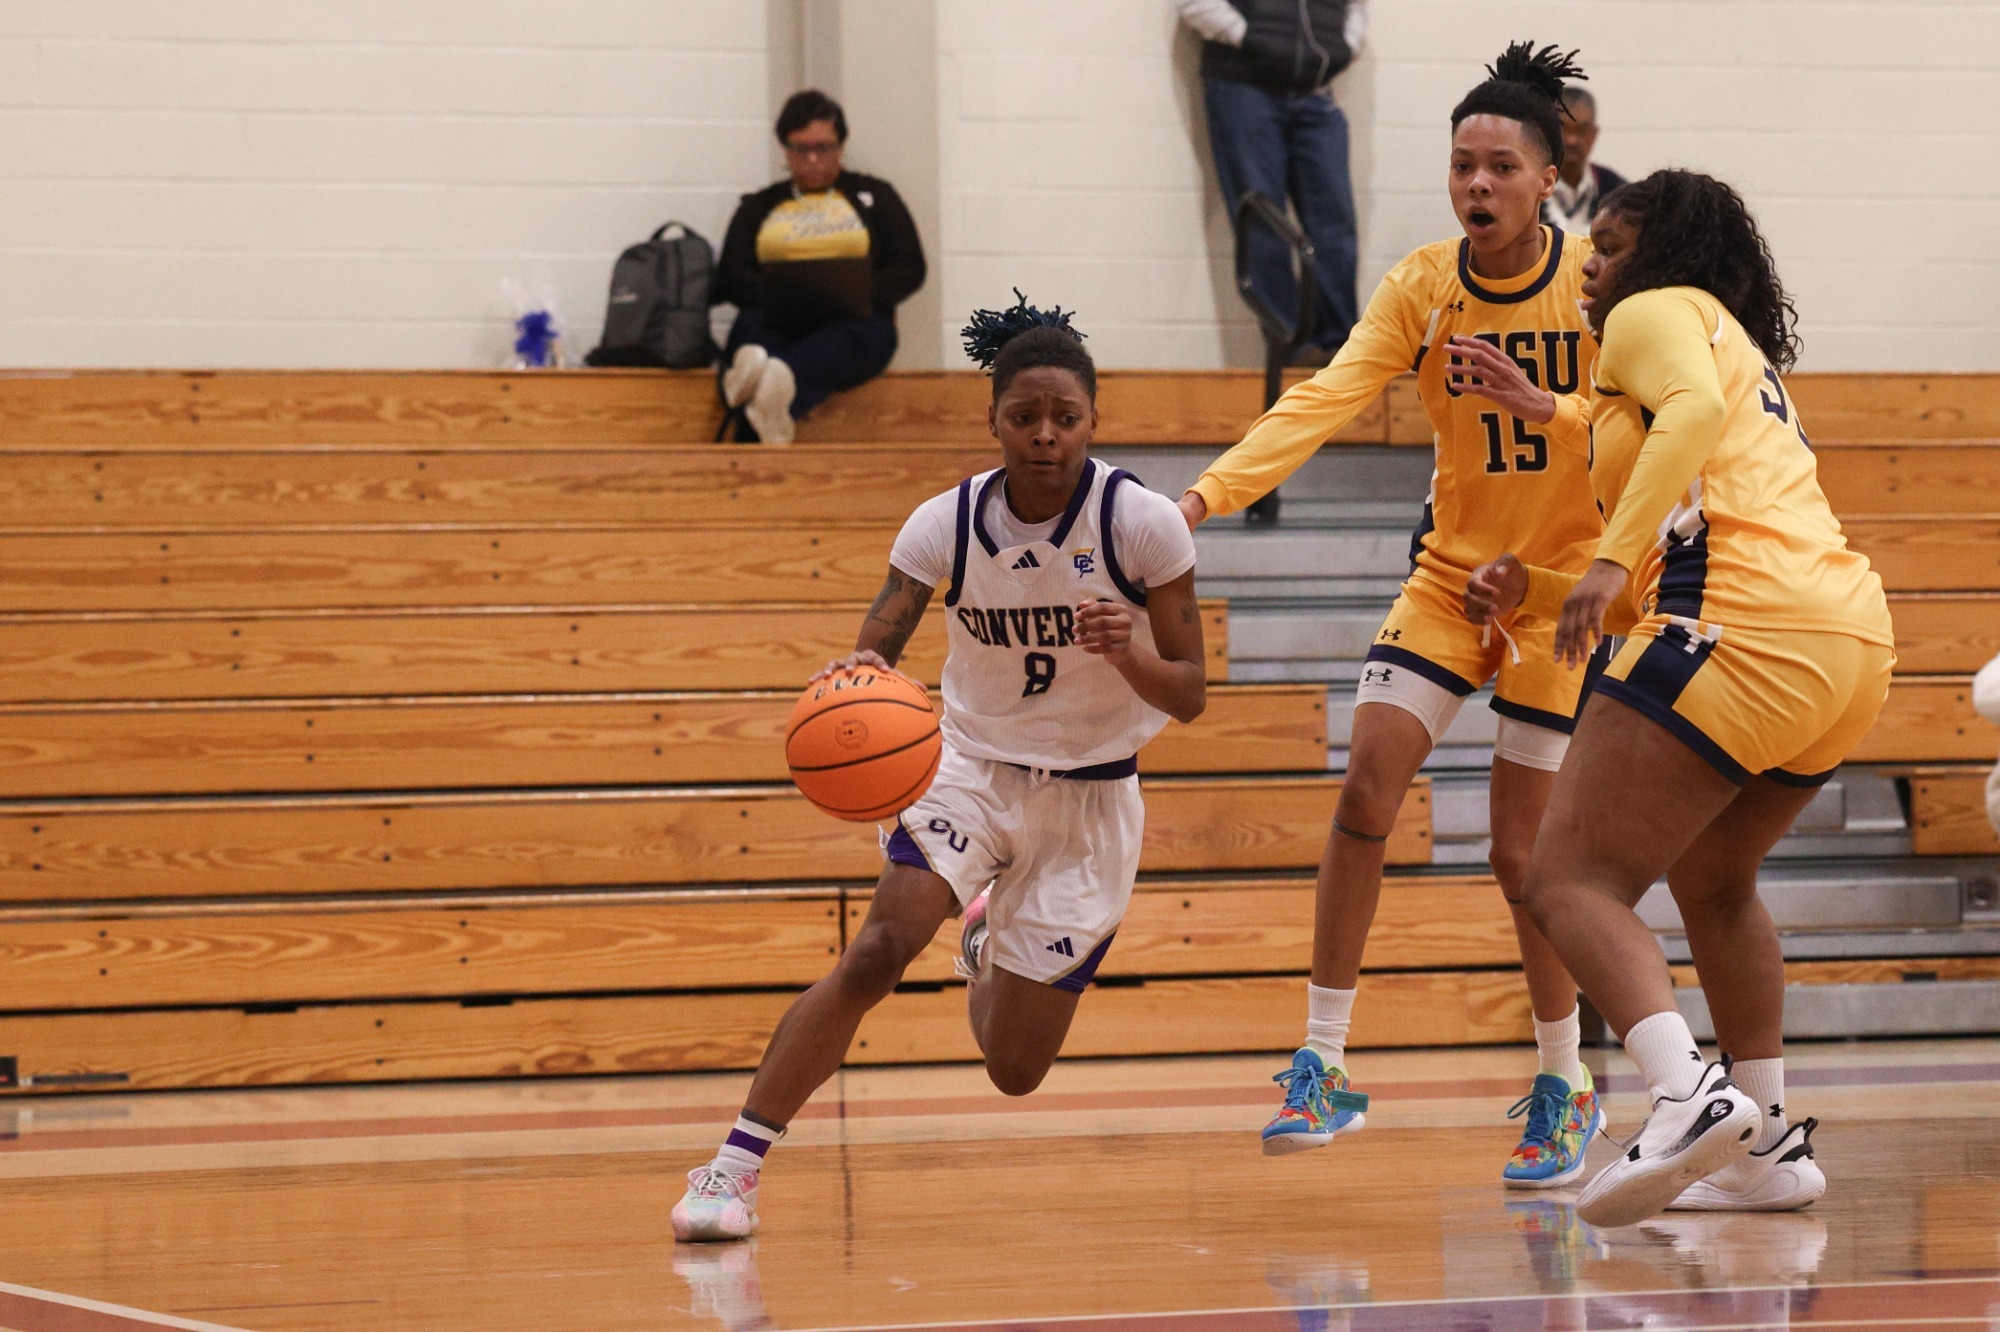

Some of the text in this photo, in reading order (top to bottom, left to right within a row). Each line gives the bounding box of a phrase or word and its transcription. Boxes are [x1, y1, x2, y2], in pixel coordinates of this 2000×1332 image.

[1480, 411, 1549, 474] 15
[957, 597, 1114, 648] CONVER
[1022, 651, 1056, 698] 8
[929, 818, 969, 853] CU
